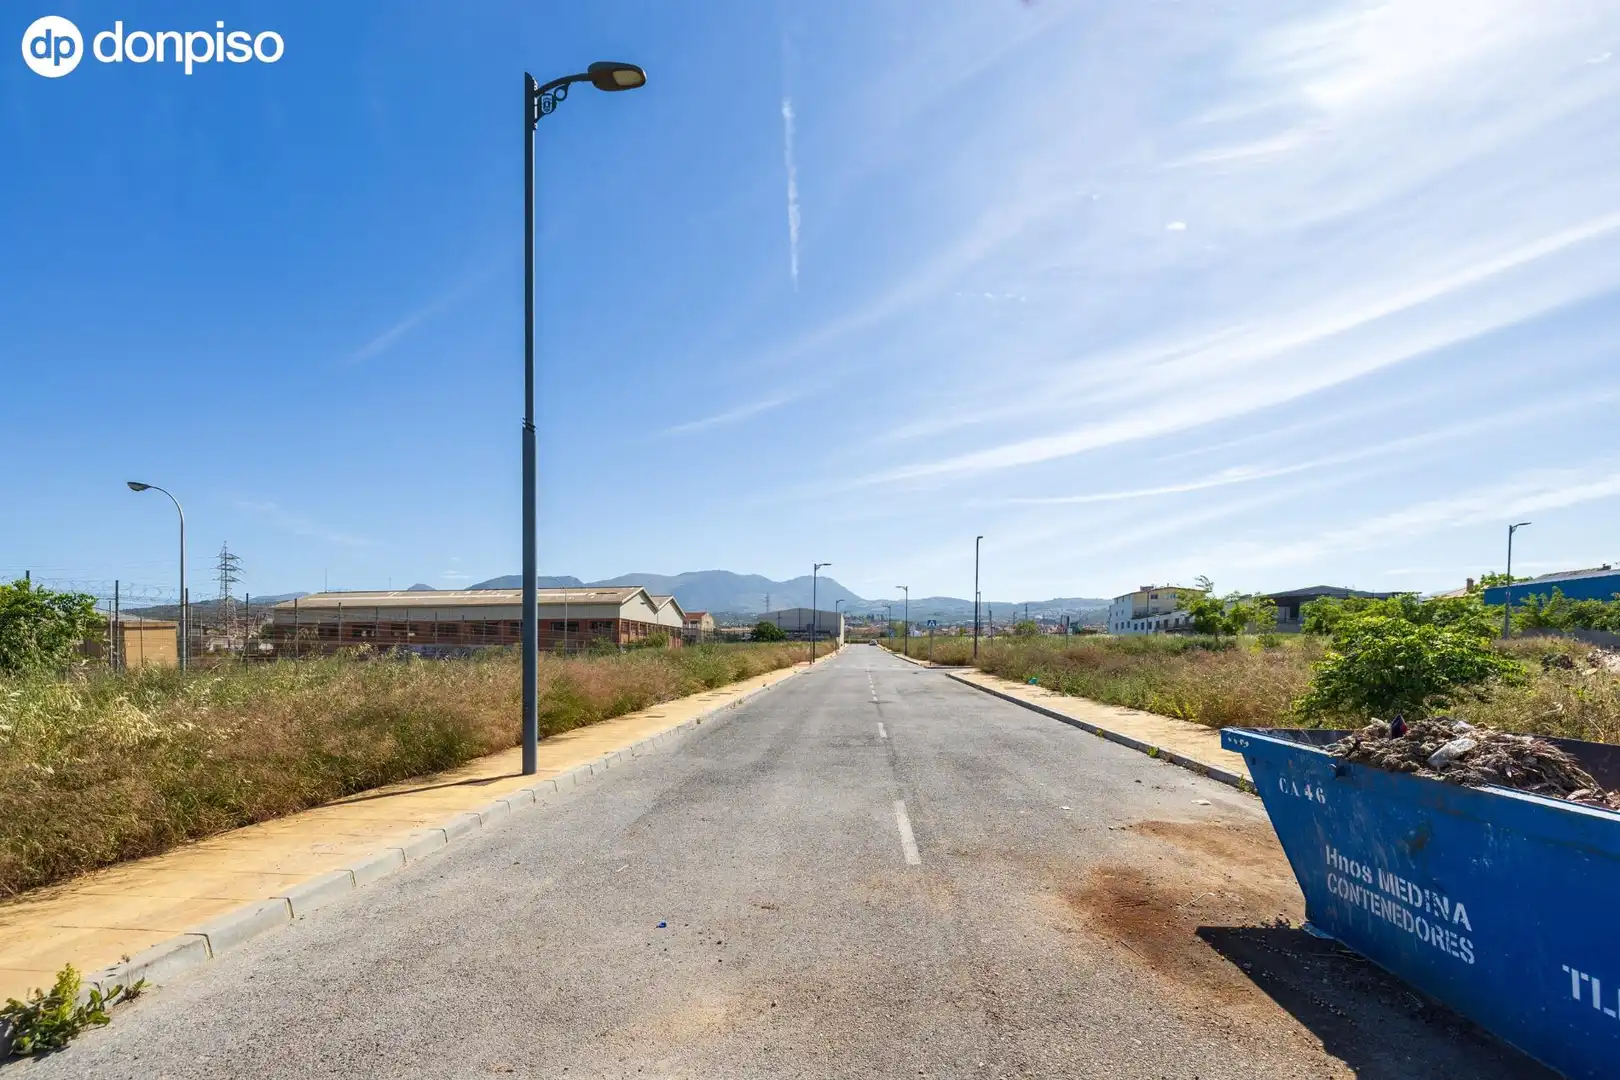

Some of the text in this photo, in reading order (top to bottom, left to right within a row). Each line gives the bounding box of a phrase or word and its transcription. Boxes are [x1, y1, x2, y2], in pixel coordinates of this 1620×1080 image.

[1325, 844, 1473, 932] Hnos MEDINA
[1326, 872, 1476, 965] CONTENEDORES
[1562, 963, 1620, 1021] TL
